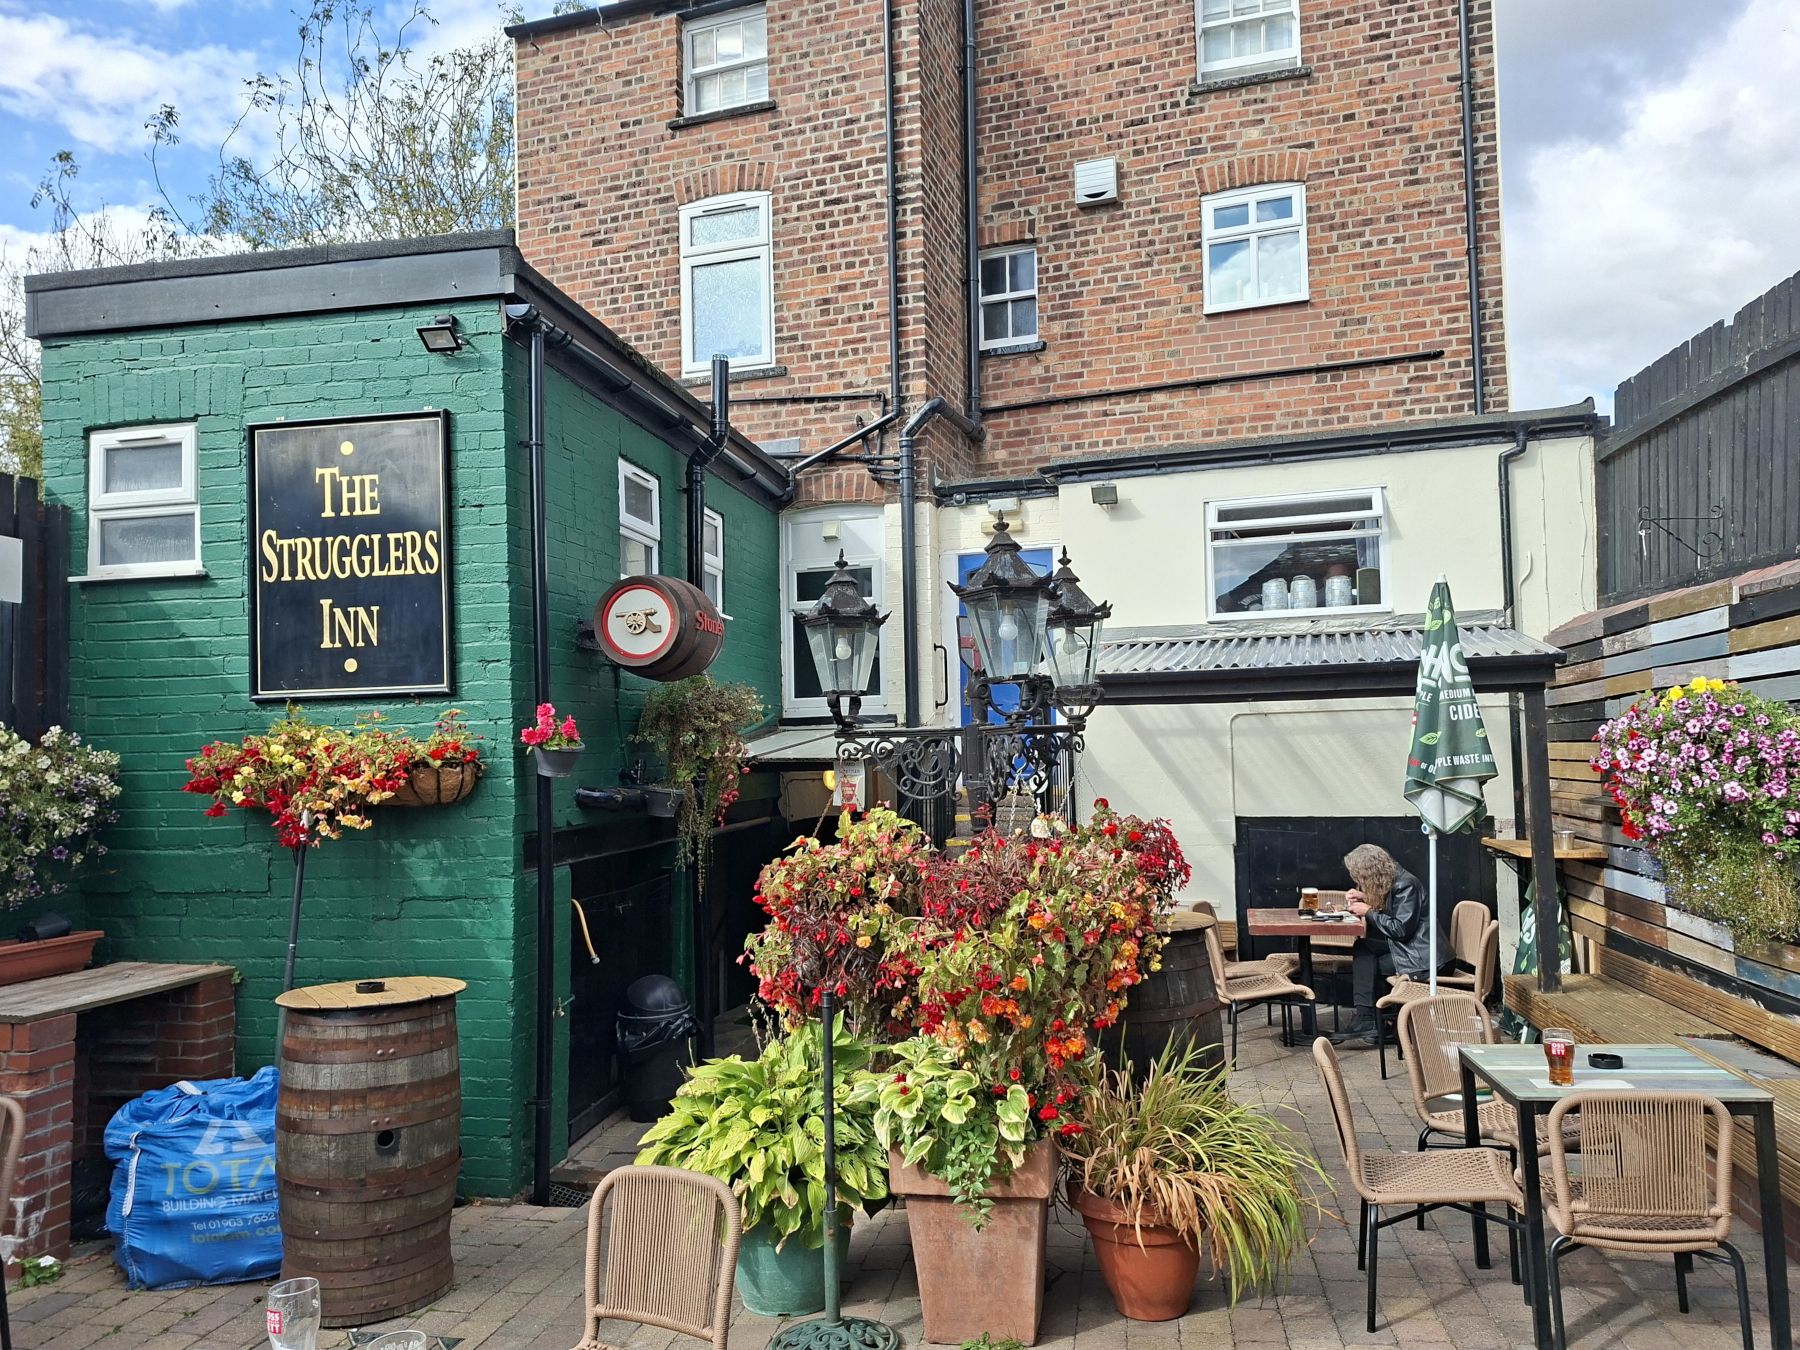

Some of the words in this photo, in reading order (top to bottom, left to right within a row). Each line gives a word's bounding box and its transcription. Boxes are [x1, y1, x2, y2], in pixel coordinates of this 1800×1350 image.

[315, 467, 381, 517] THE
[262, 529, 440, 583] STRUGGLERS
[319, 599, 380, 649] INN
[1453, 753, 1480, 766] WASTE
[162, 1195, 226, 1213] BUILDING
[191, 1221, 207, 1231] Tel
